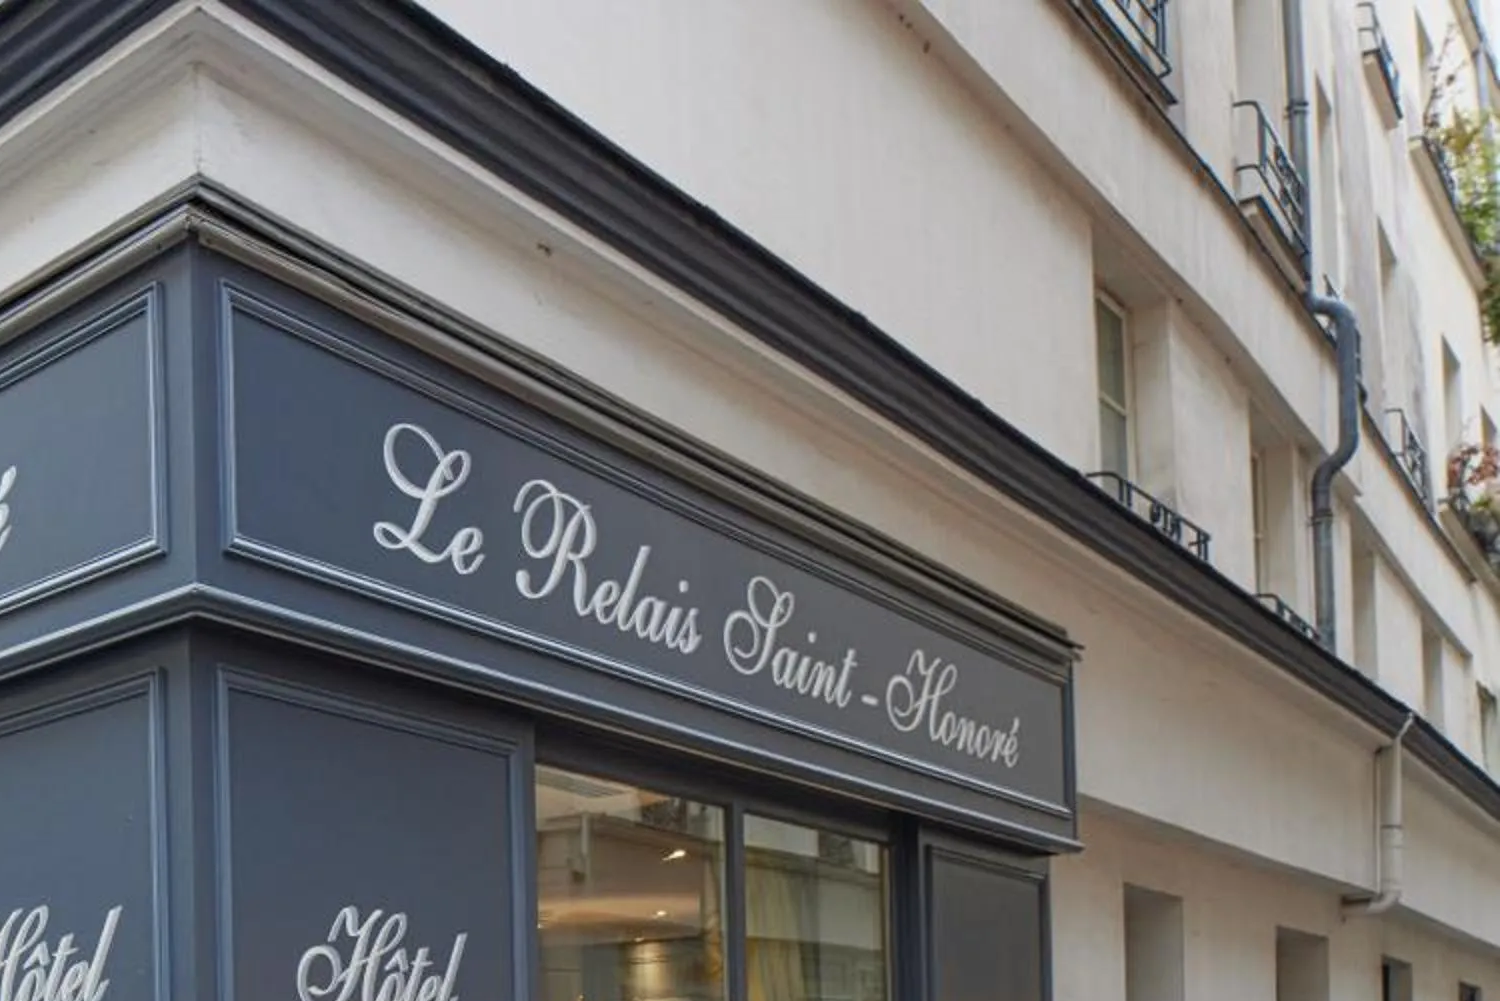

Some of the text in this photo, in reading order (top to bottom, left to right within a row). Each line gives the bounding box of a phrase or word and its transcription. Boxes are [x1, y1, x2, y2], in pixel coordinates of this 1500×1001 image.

[373, 423, 1021, 768] Le Relais Saint-Honoré
